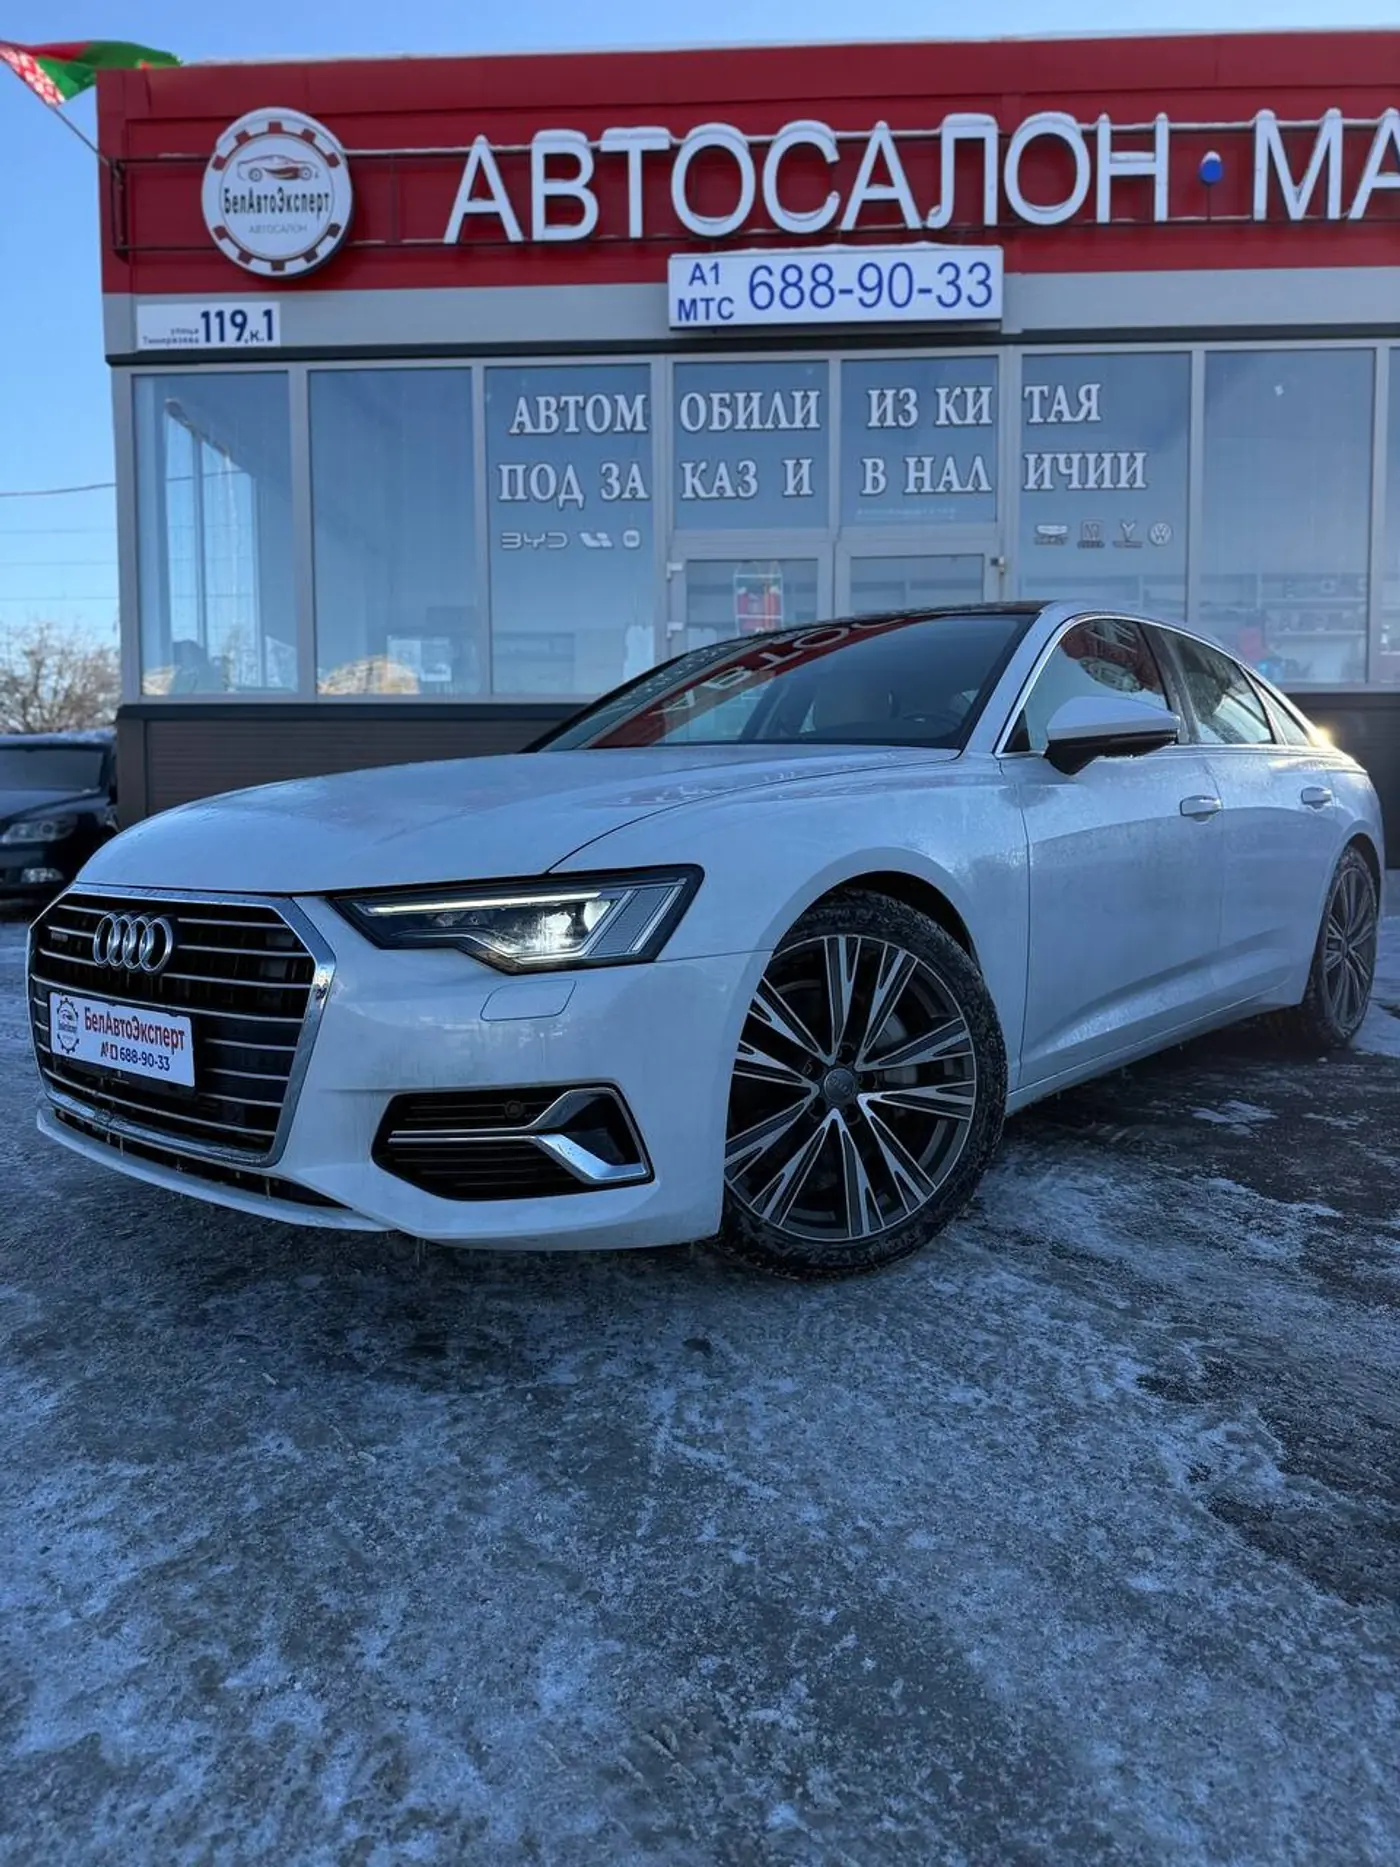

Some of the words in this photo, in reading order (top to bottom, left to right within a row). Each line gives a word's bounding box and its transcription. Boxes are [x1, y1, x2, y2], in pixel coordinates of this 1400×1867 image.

[443, 113, 1170, 244] АВТОСАЛОН
[223, 186, 330, 220] БелАвтоЭксперт
[677, 297, 735, 321] МТС
[748, 262, 993, 311] 688-90-33
[867, 387, 919, 428] ИЗ
[498, 463, 585, 509] ПОД
[782, 458, 814, 497] И
[860, 458, 887, 496] В
[84, 1006, 185, 1055] БелАвтоЭксперт
[119, 1046, 170, 1072] 688-90-33
